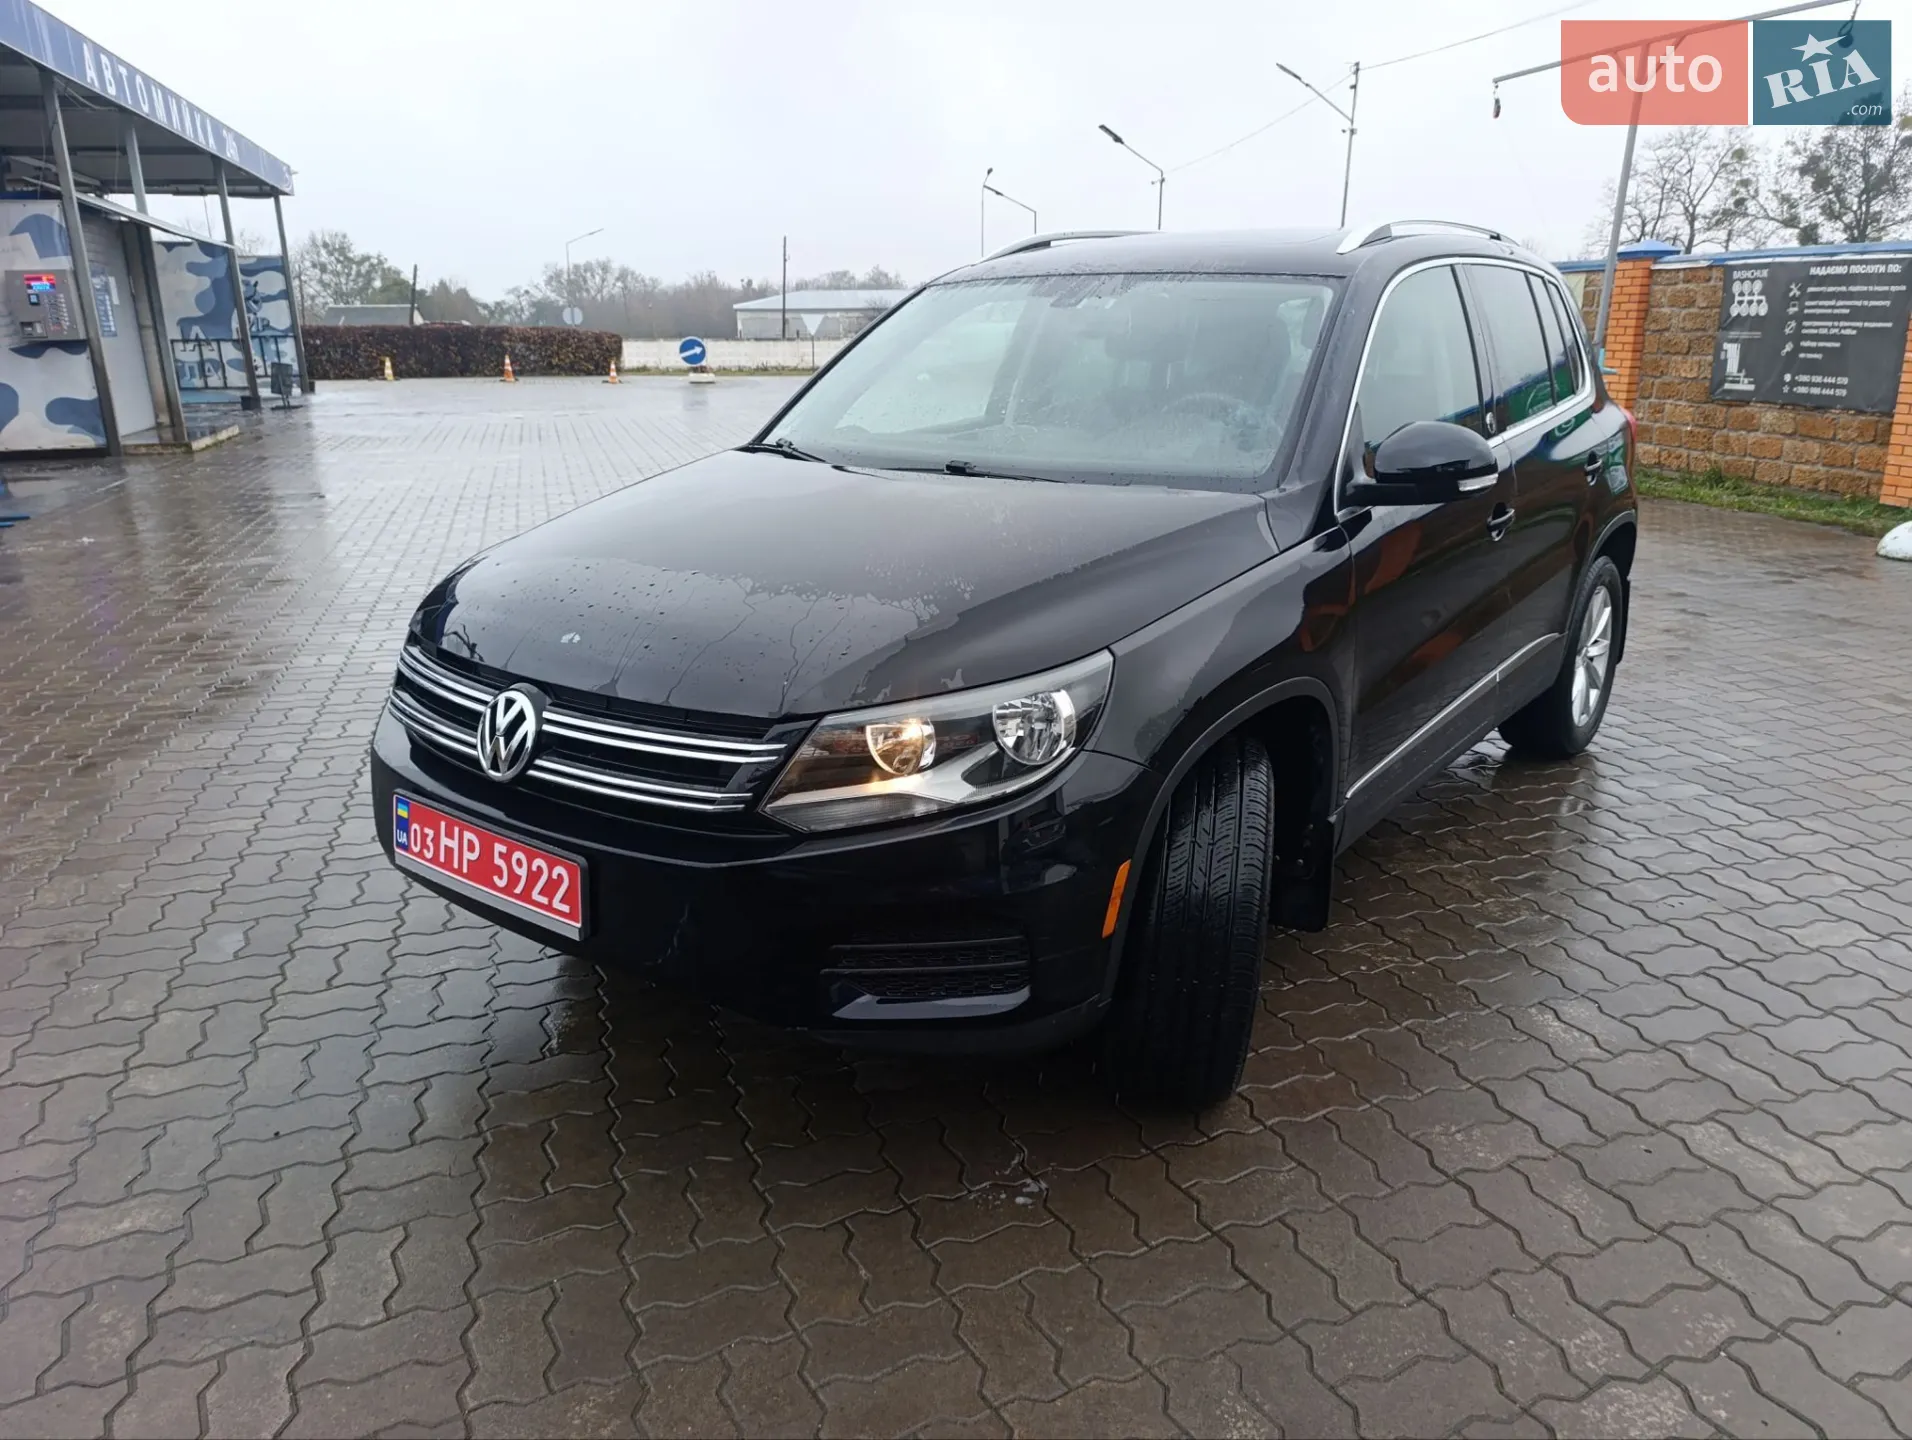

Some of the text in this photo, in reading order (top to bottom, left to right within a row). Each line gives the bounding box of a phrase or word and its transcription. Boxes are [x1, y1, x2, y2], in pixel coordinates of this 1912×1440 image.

[82, 41, 217, 150] АВТОМИЙКА
[1887, 263, 1902, 274] ПО:
[396, 829, 408, 845] UA
[492, 842, 571, 914] 5922
